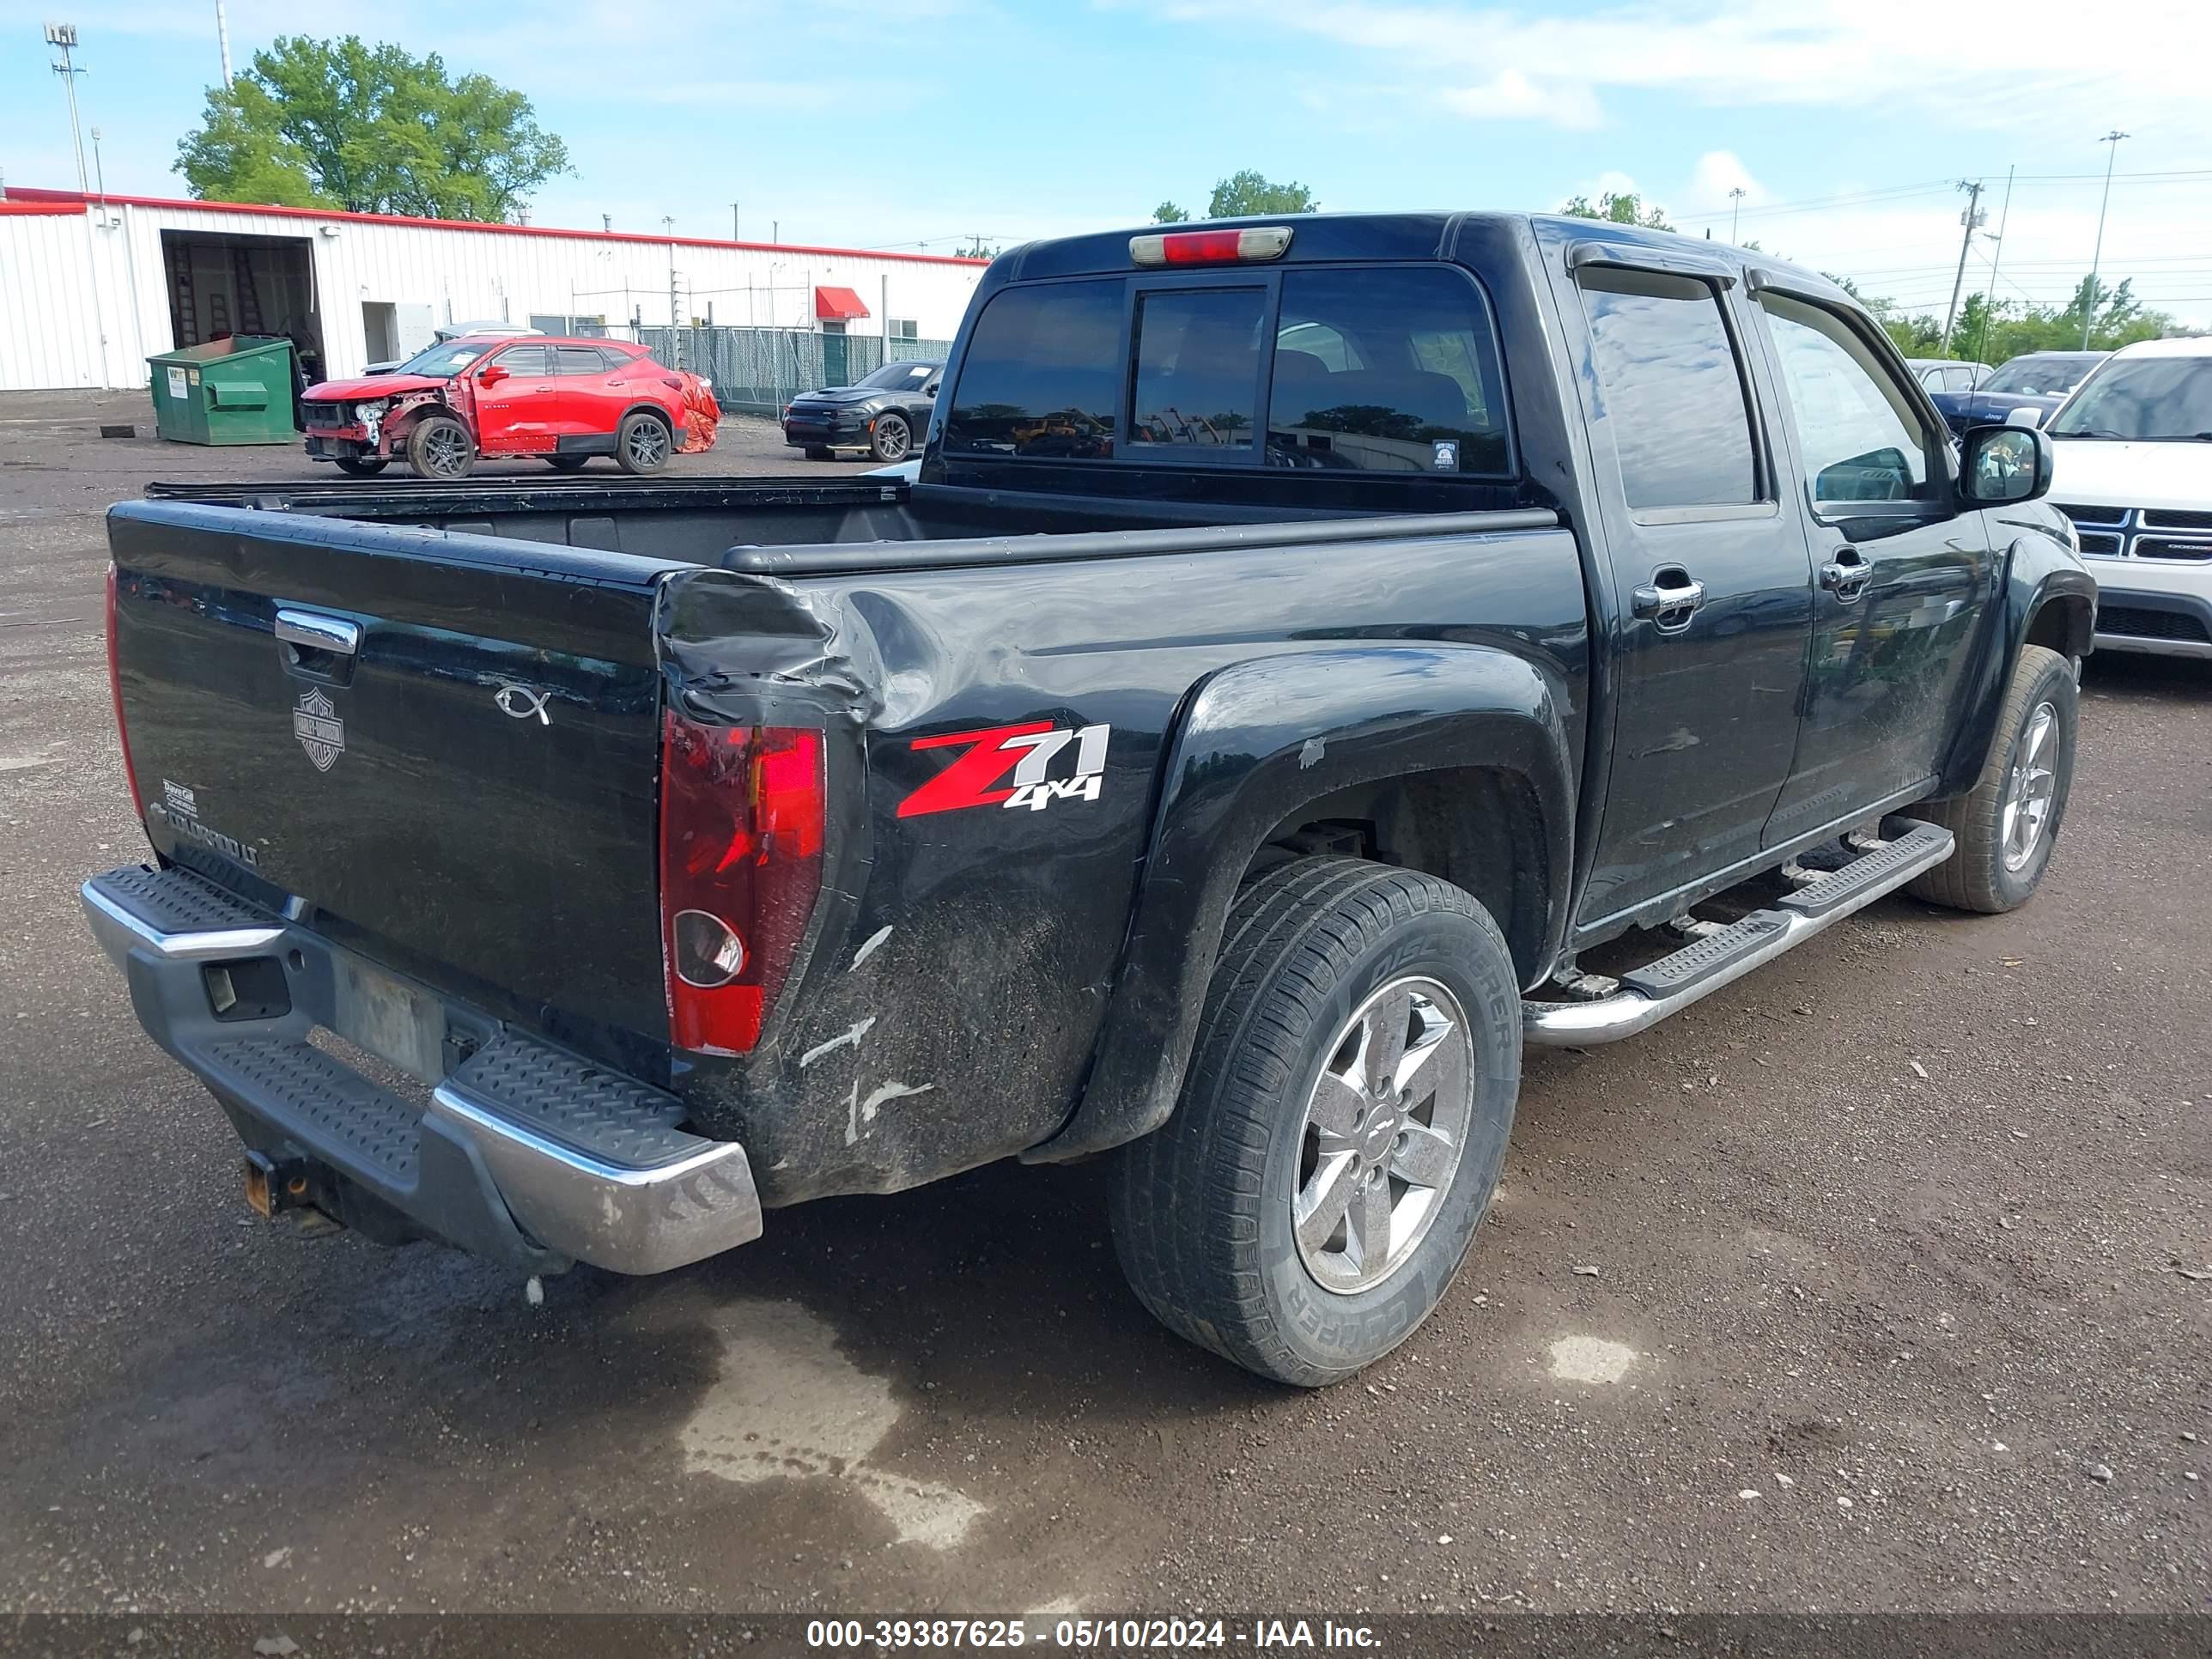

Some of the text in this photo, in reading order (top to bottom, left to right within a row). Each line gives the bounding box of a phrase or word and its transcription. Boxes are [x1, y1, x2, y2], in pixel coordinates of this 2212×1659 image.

[305, 696, 330, 719] MOTOR
[296, 714, 341, 743] HARLEY-DAVIDSON
[308, 738, 332, 764] CYCLES
[896, 719, 1110, 818] Z71
